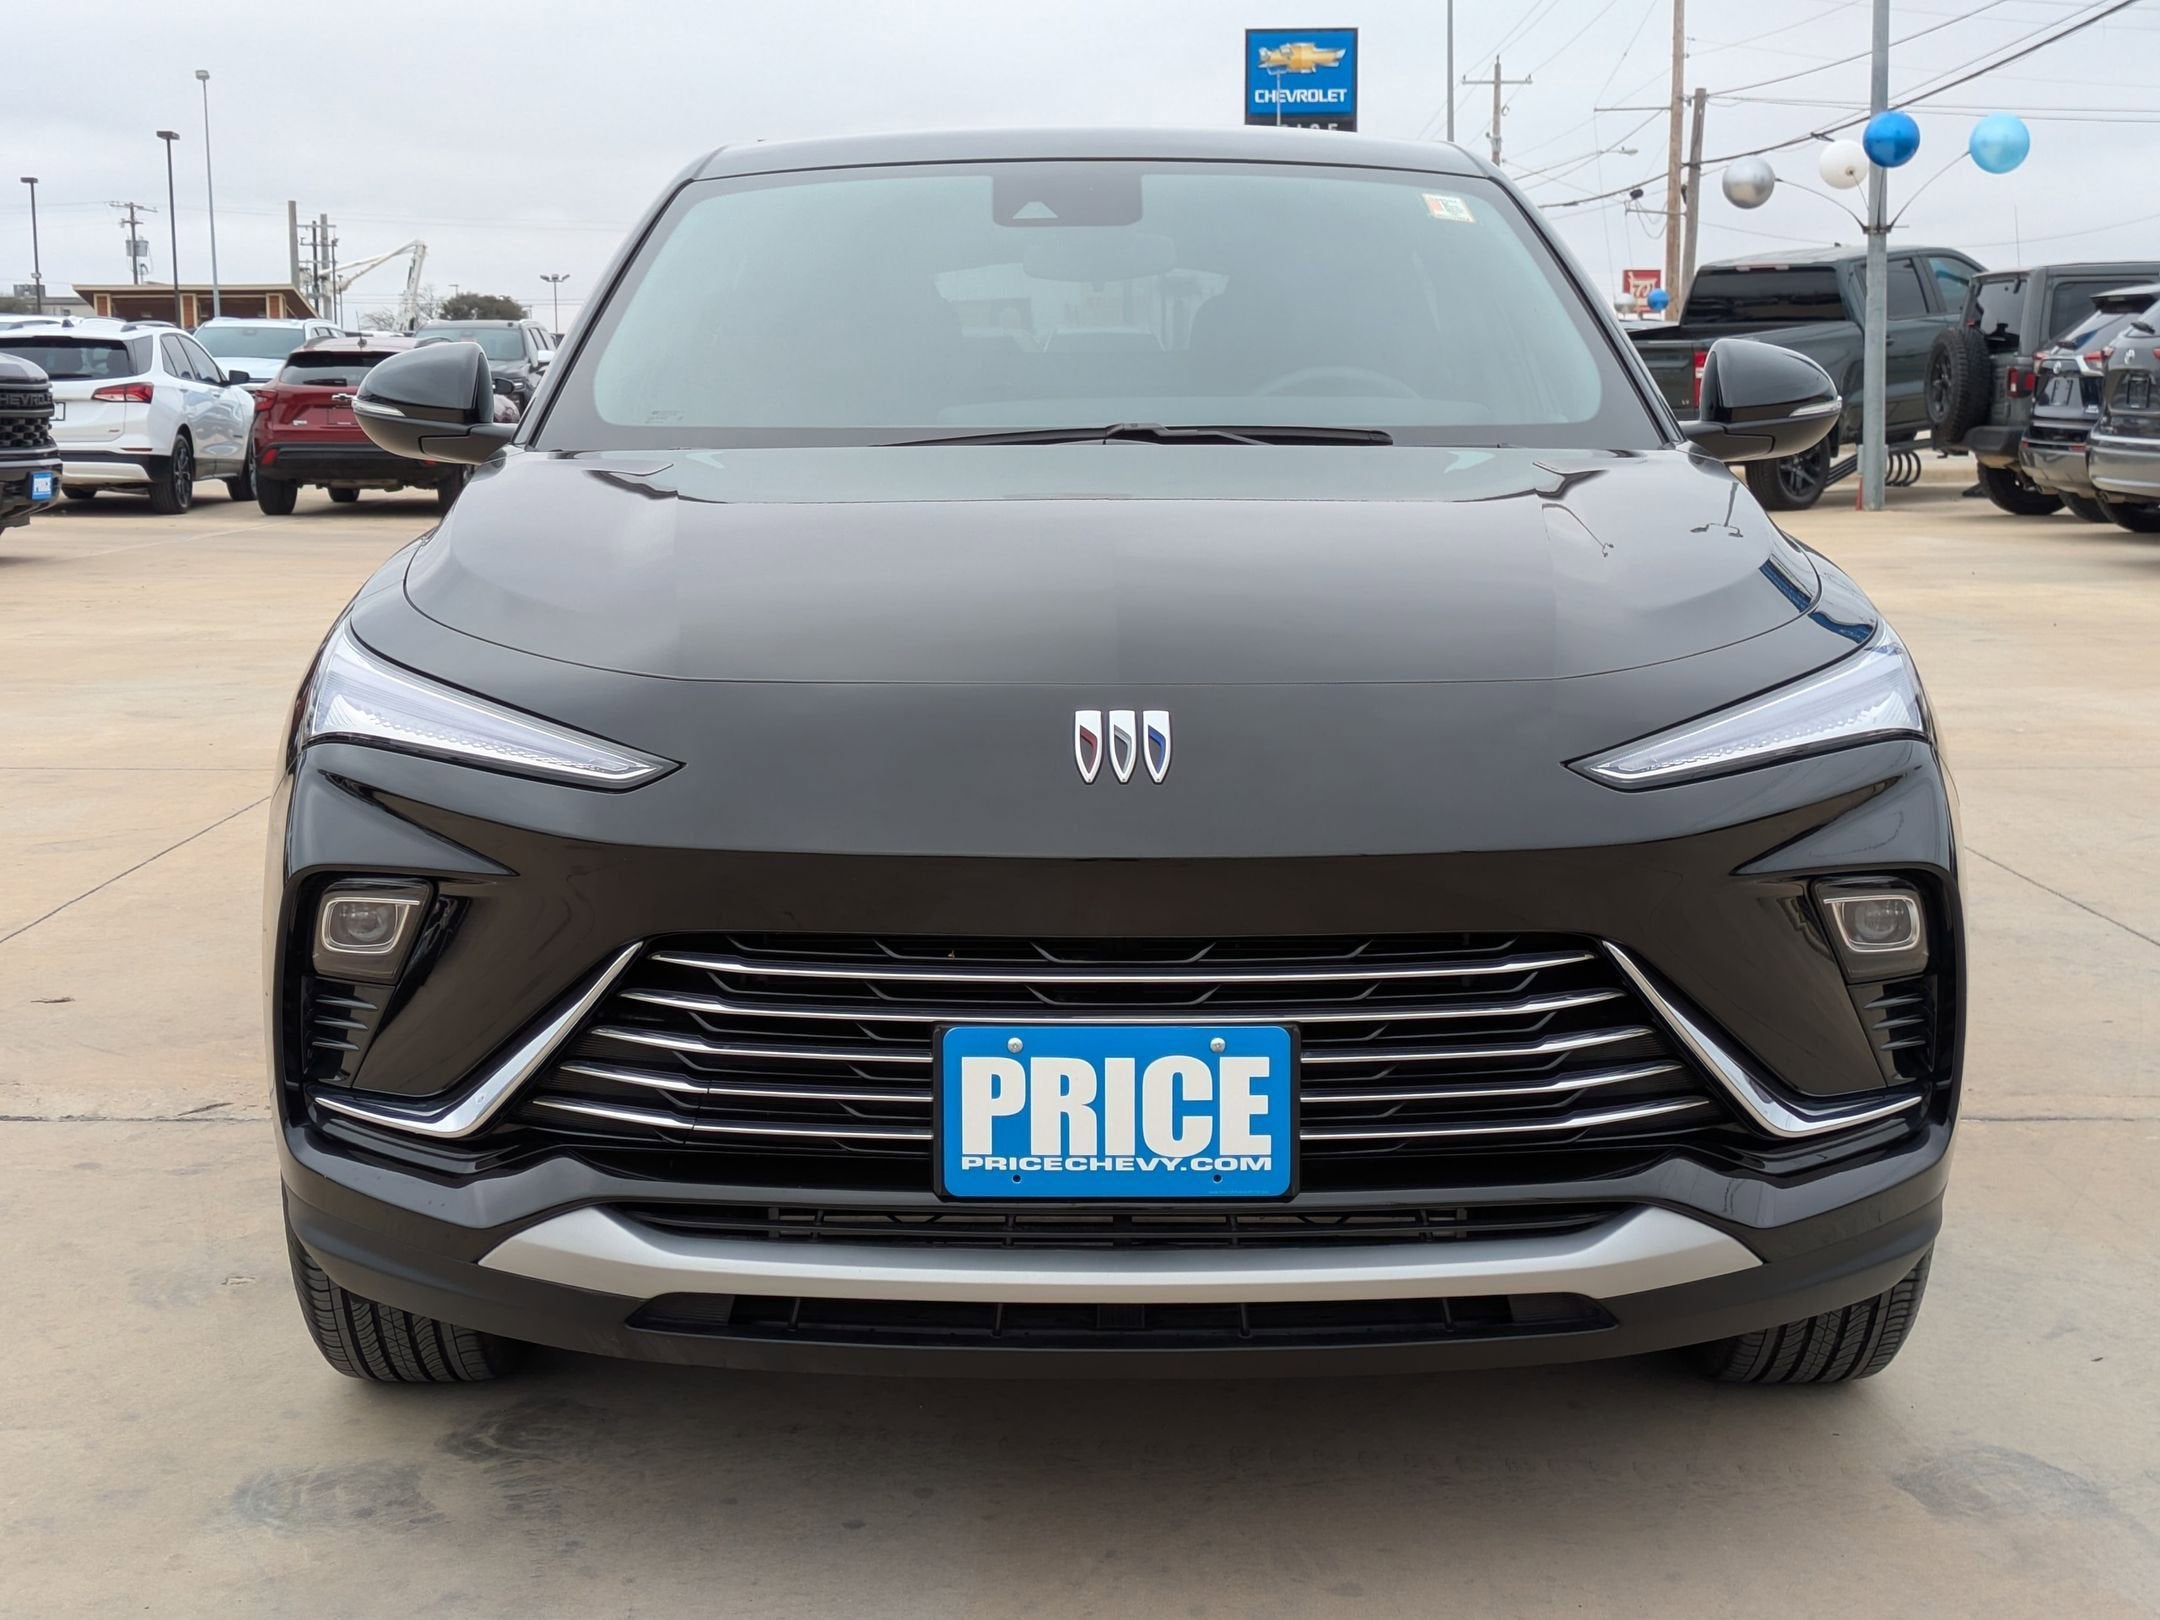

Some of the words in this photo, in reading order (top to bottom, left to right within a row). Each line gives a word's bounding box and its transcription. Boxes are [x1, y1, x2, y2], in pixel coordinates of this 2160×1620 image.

[1254, 88, 1348, 103] CHEVROLET
[961, 1055, 1272, 1158] PRICE
[961, 1156, 1272, 1171] PRICECHEVY.COM
